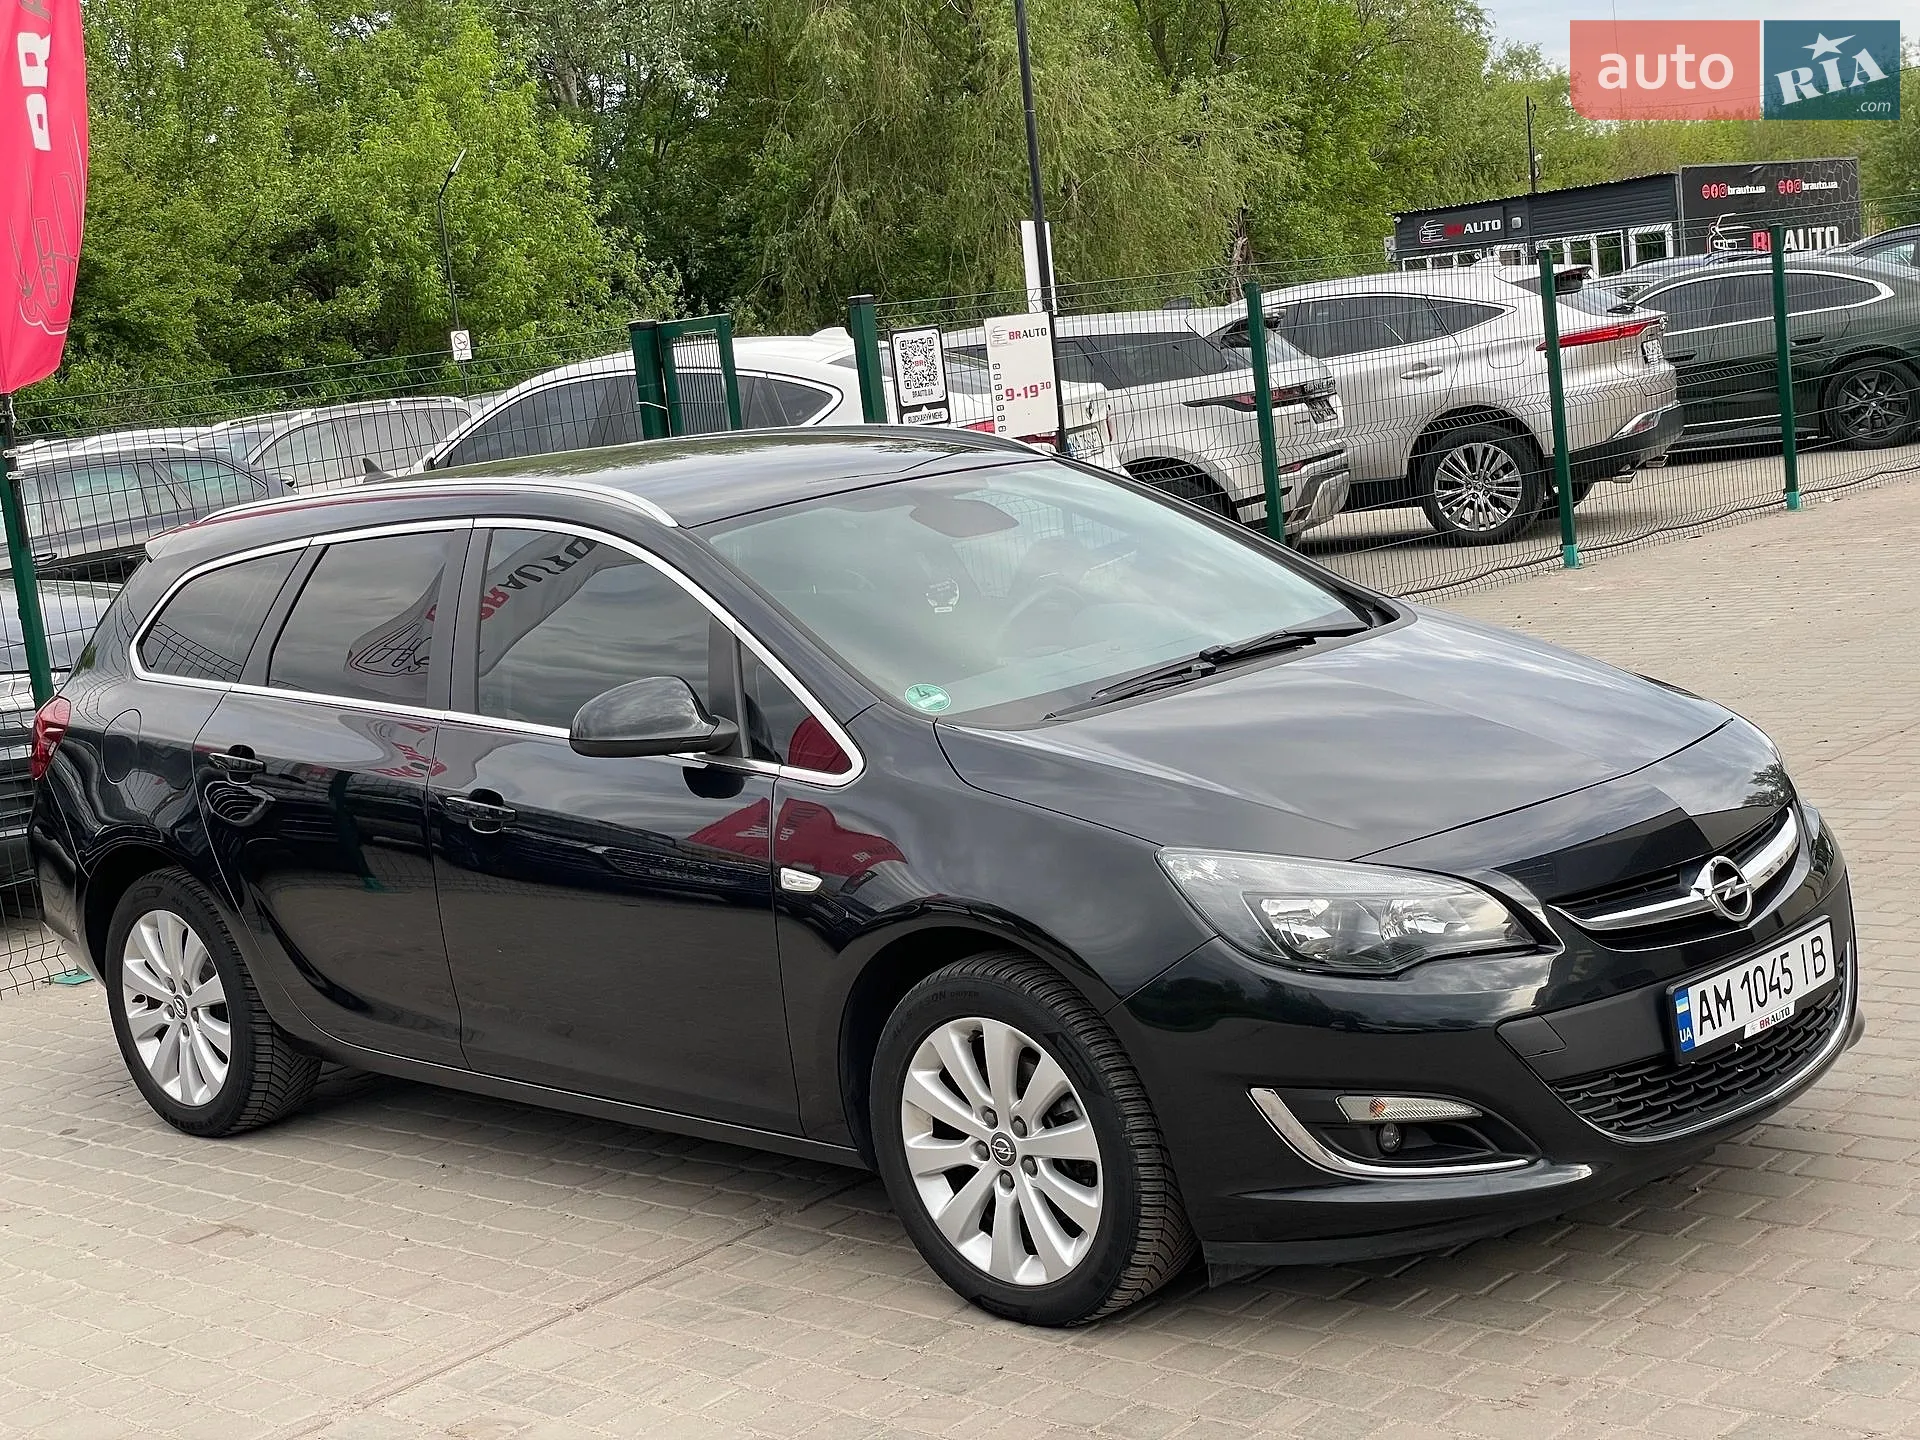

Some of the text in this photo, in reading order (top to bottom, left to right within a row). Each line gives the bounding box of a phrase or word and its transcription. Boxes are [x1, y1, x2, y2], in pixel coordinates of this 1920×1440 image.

[1727, 184, 1766, 195] brauto.ua
[1801, 180, 1838, 191] brauto.ua
[1443, 219, 1501, 237] AUTO
[1752, 226, 1839, 253] BAUTO
[1008, 327, 1047, 340] BRAUTO
[1699, 935, 1826, 1037] AM 1045 IB
[1759, 1006, 1791, 1030] BRAUTO
[1679, 1028, 1693, 1043] UA
